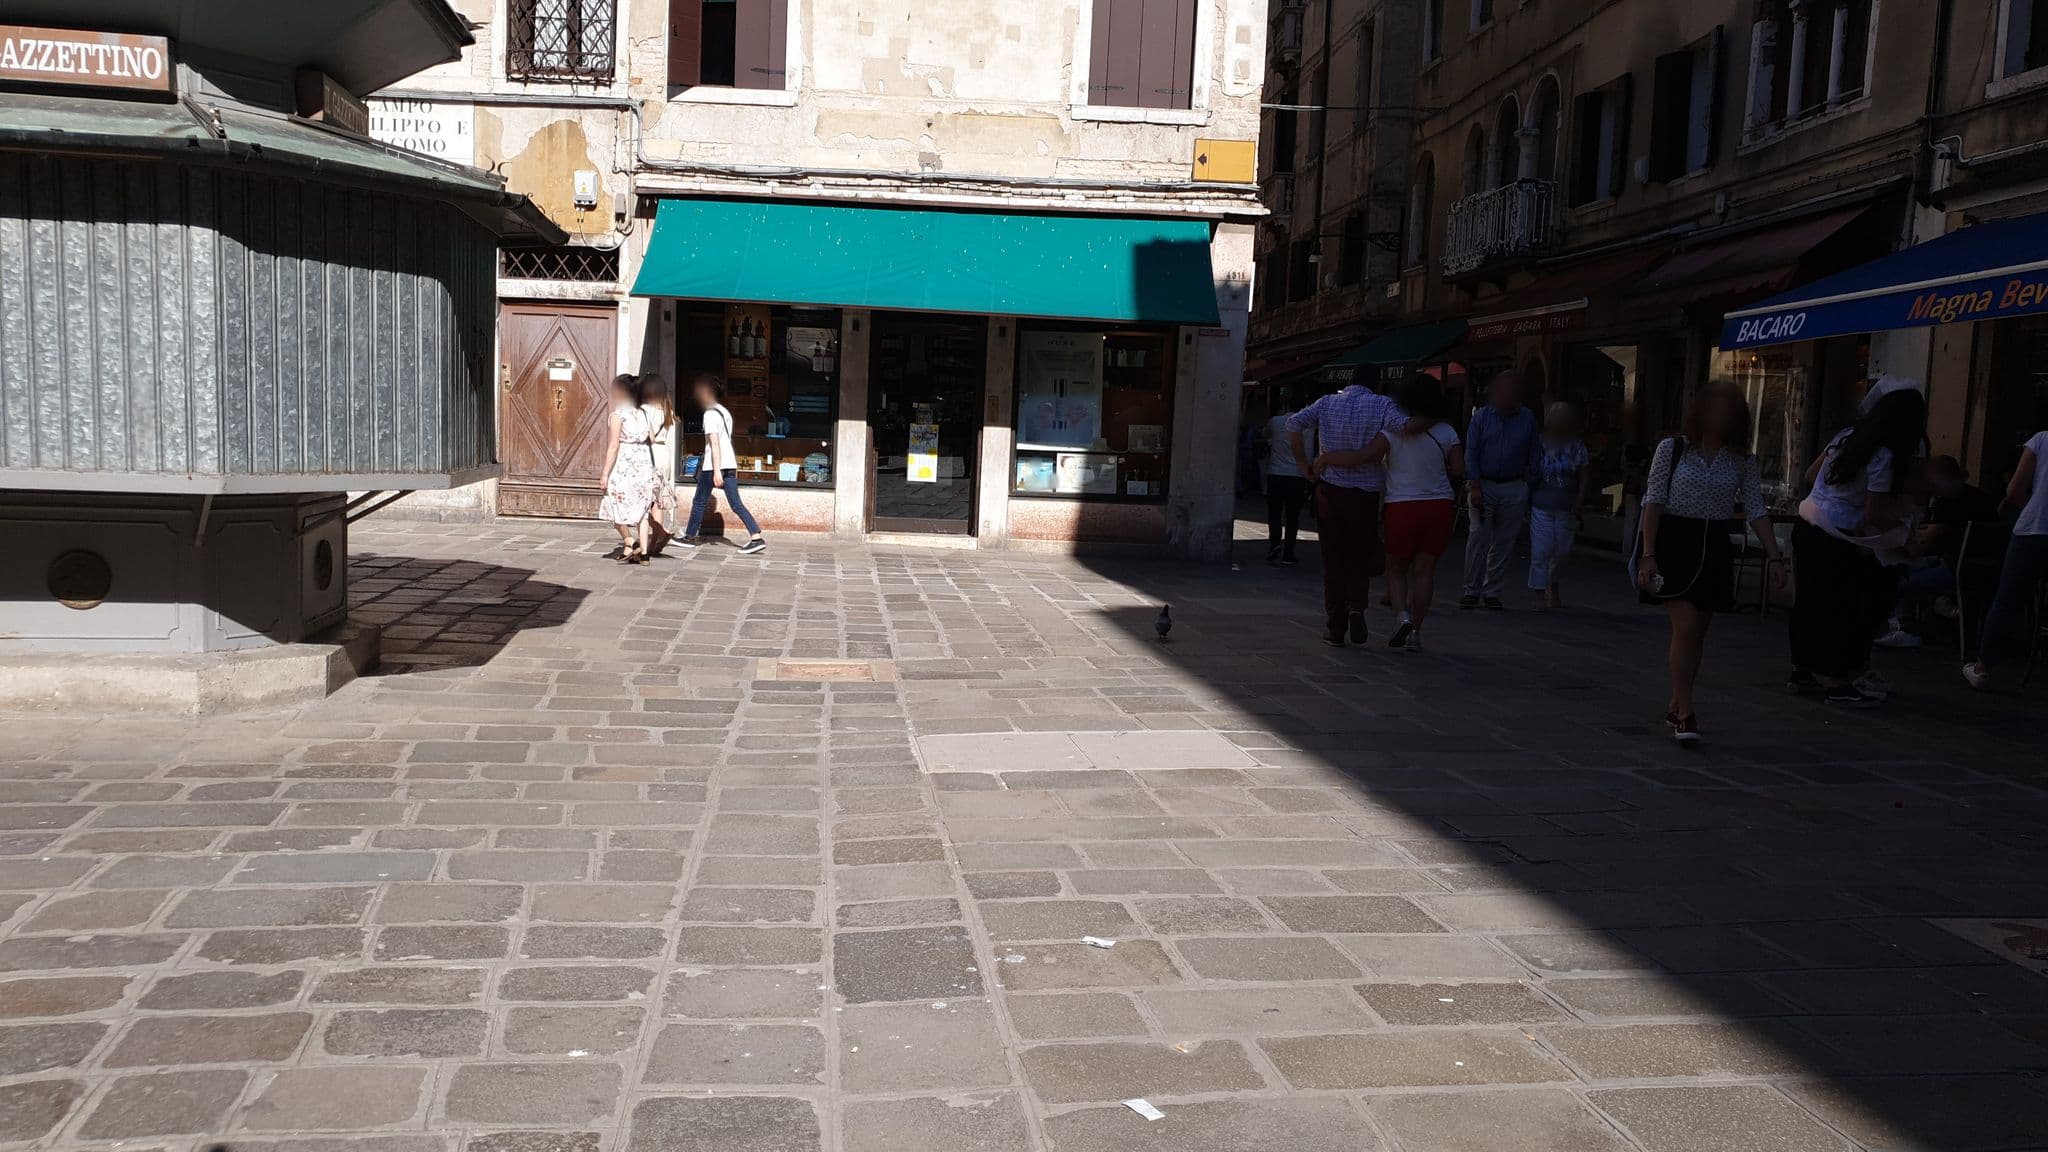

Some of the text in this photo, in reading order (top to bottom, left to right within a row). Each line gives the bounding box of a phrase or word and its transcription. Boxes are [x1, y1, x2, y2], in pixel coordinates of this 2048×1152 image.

[0, 37, 162, 79] AZZETTINO
[371, 117, 468, 135] ILIPPO E
[1907, 278, 2048, 323] Magna Bev
[1736, 312, 1807, 343] BACARO
